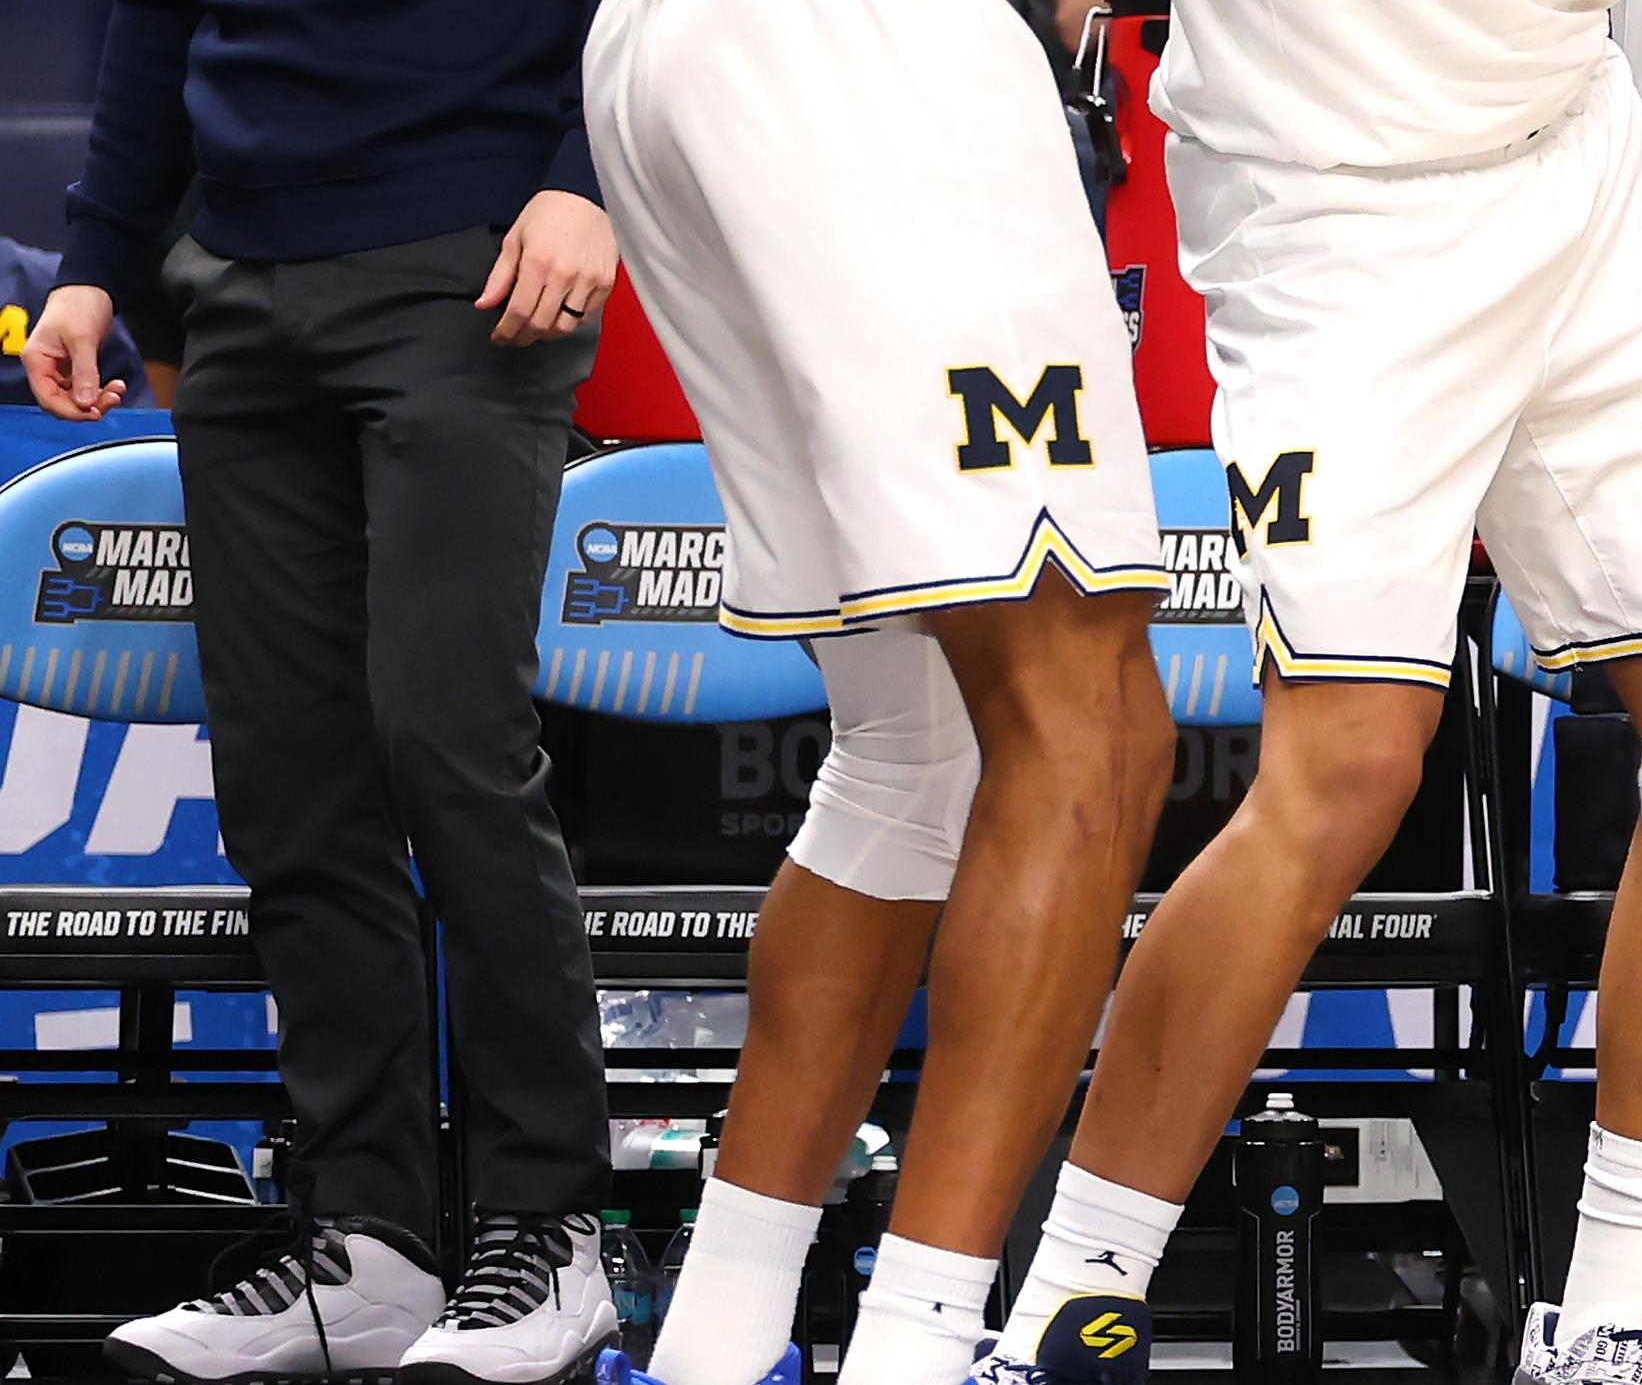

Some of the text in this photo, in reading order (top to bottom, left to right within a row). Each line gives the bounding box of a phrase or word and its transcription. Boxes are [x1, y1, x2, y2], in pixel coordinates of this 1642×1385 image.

[945, 364, 1096, 475] M
[1225, 449, 1318, 561] M
[7, 910, 51, 937] THE
[55, 910, 121, 937] ROAD
[126, 910, 158, 937] TO
[162, 910, 207, 937] THE
[611, 911, 676, 938] ROAD
[680, 911, 711, 937] TO
[716, 912, 760, 938] THE
[1370, 914, 1434, 940] FOUR
[1275, 1230, 1296, 1354] BODYARMOR
